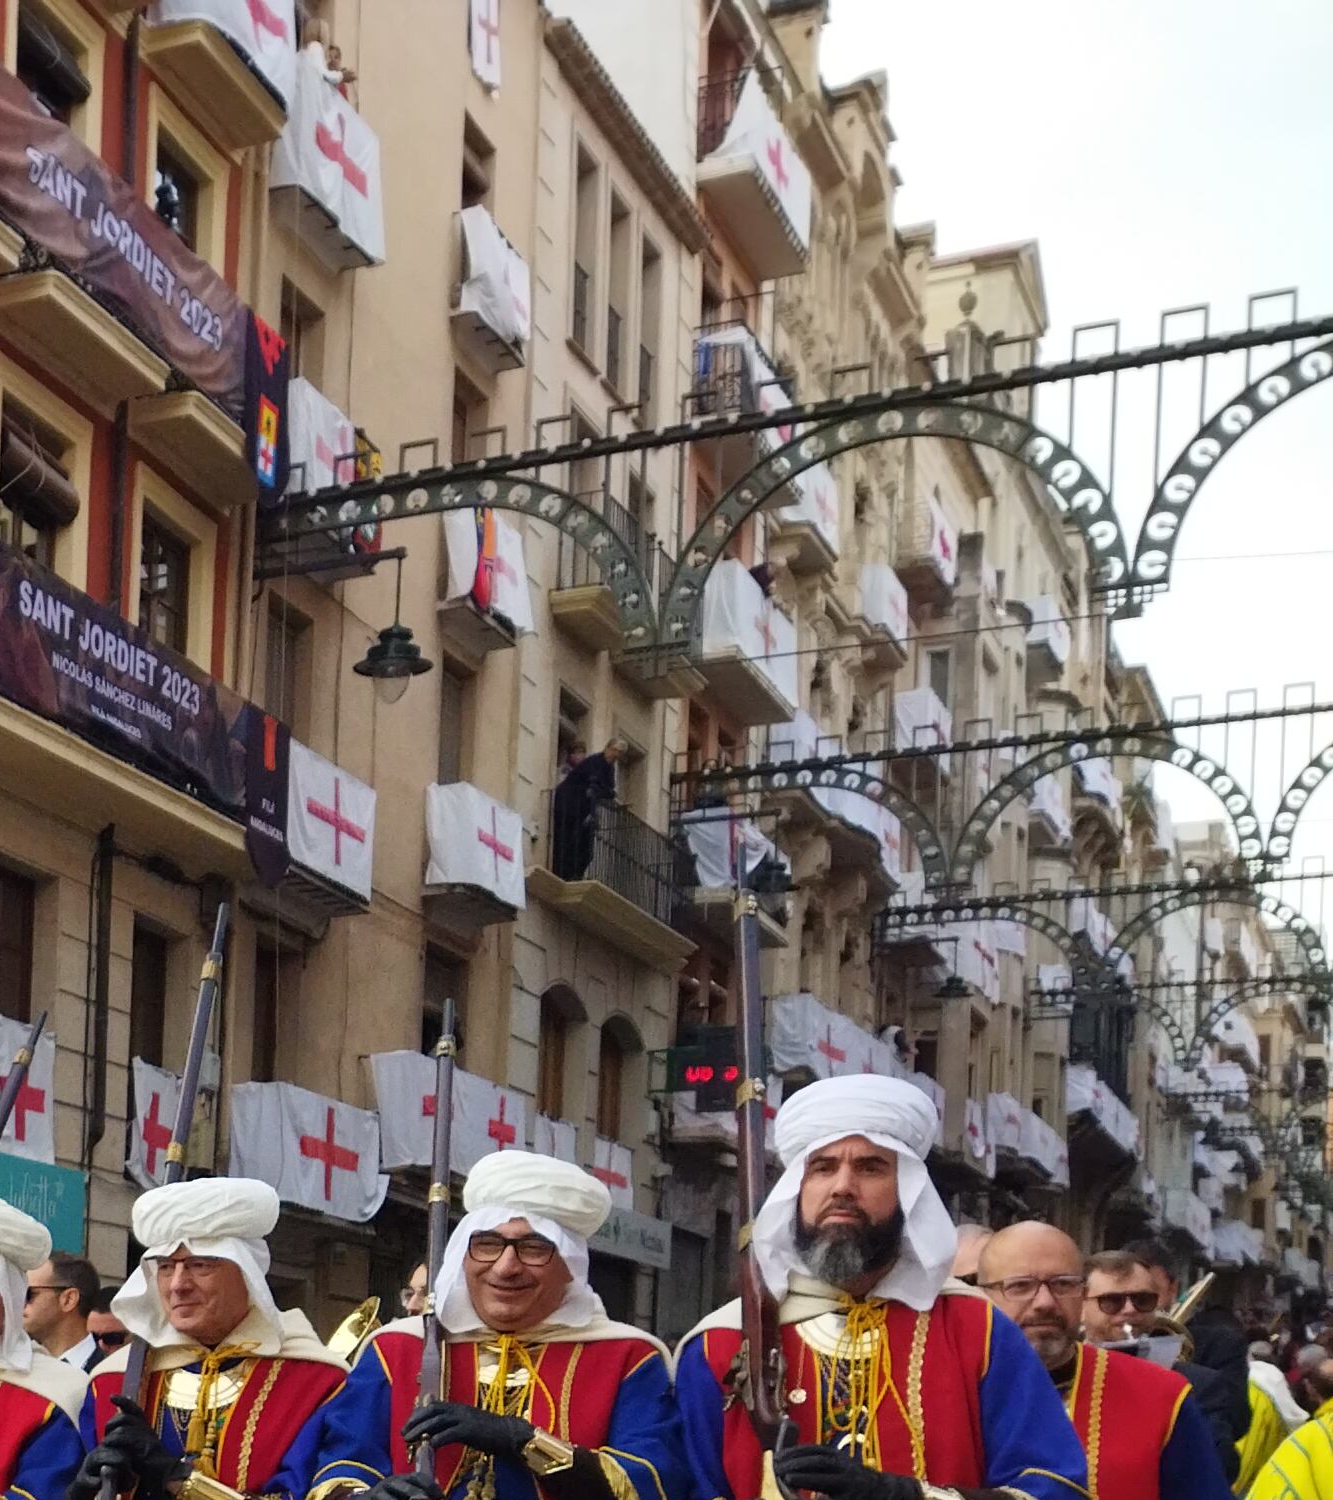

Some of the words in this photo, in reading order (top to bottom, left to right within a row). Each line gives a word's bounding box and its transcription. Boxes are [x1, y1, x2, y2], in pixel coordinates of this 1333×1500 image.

[26, 146, 87, 219] SANT
[91, 202, 176, 305] JORDIET
[180, 288, 224, 351] 2023
[19, 580, 75, 640] SANT
[78, 618, 158, 687] JORDIET
[161, 665, 200, 716] 2023
